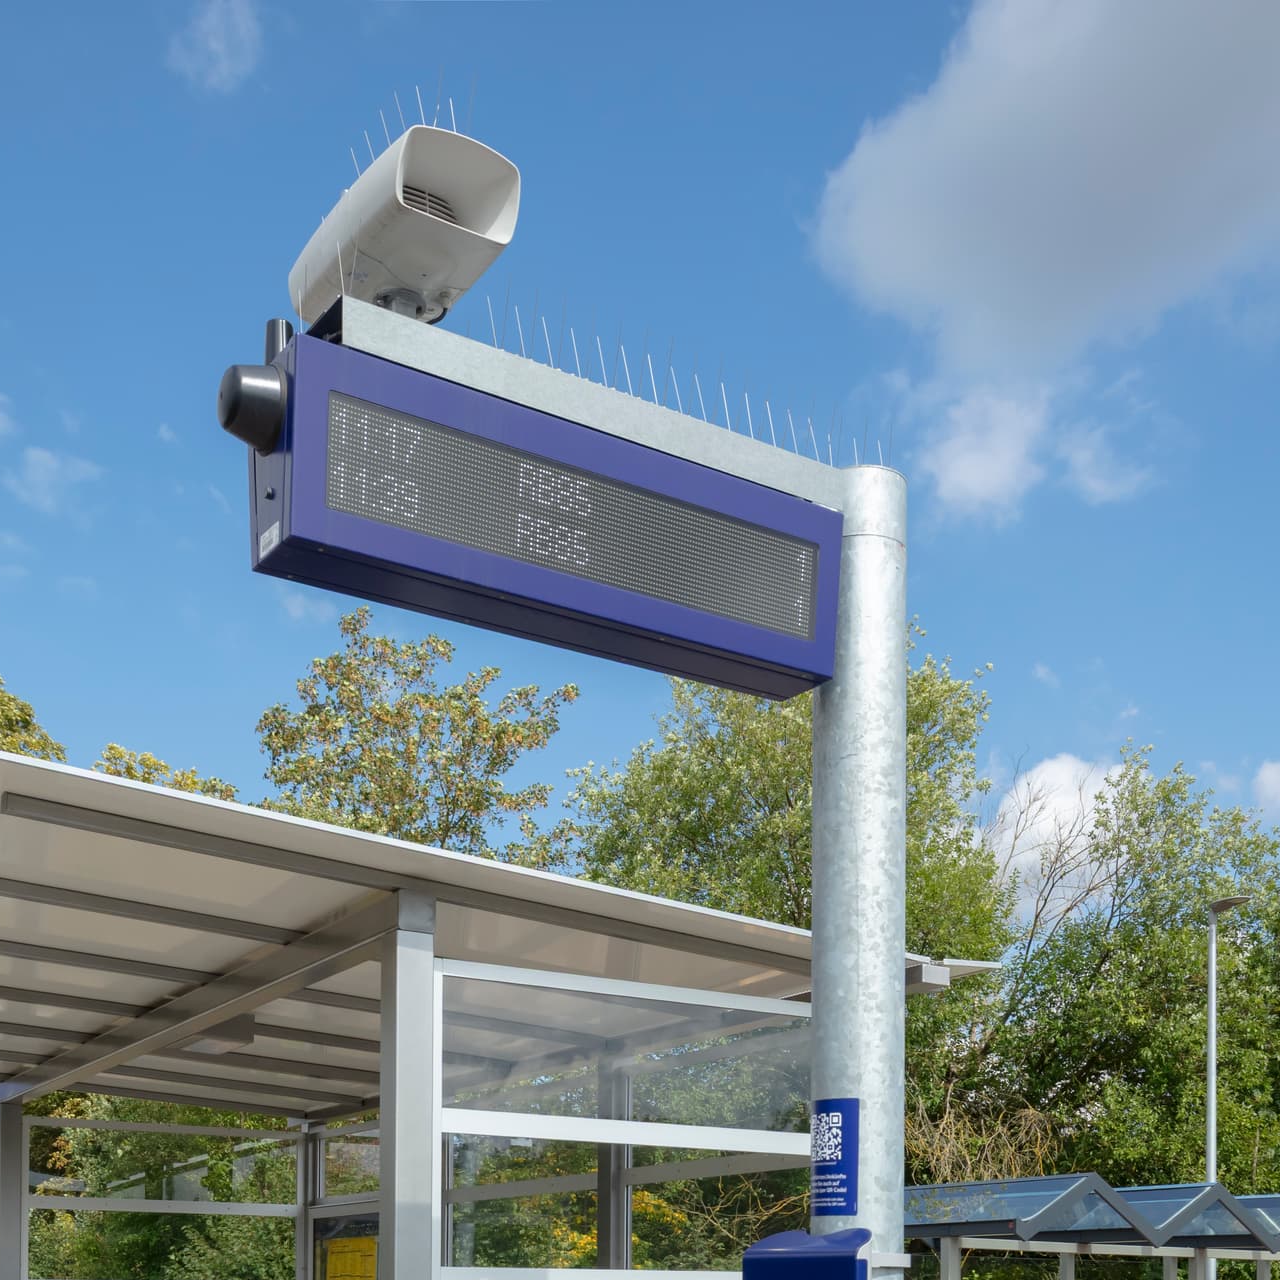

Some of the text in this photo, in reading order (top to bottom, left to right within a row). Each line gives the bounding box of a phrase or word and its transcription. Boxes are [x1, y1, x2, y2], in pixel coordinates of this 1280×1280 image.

[332, 461, 803, 626] 11:39 RB85 1
[334, 407, 806, 582] 11:17 RB85 1
